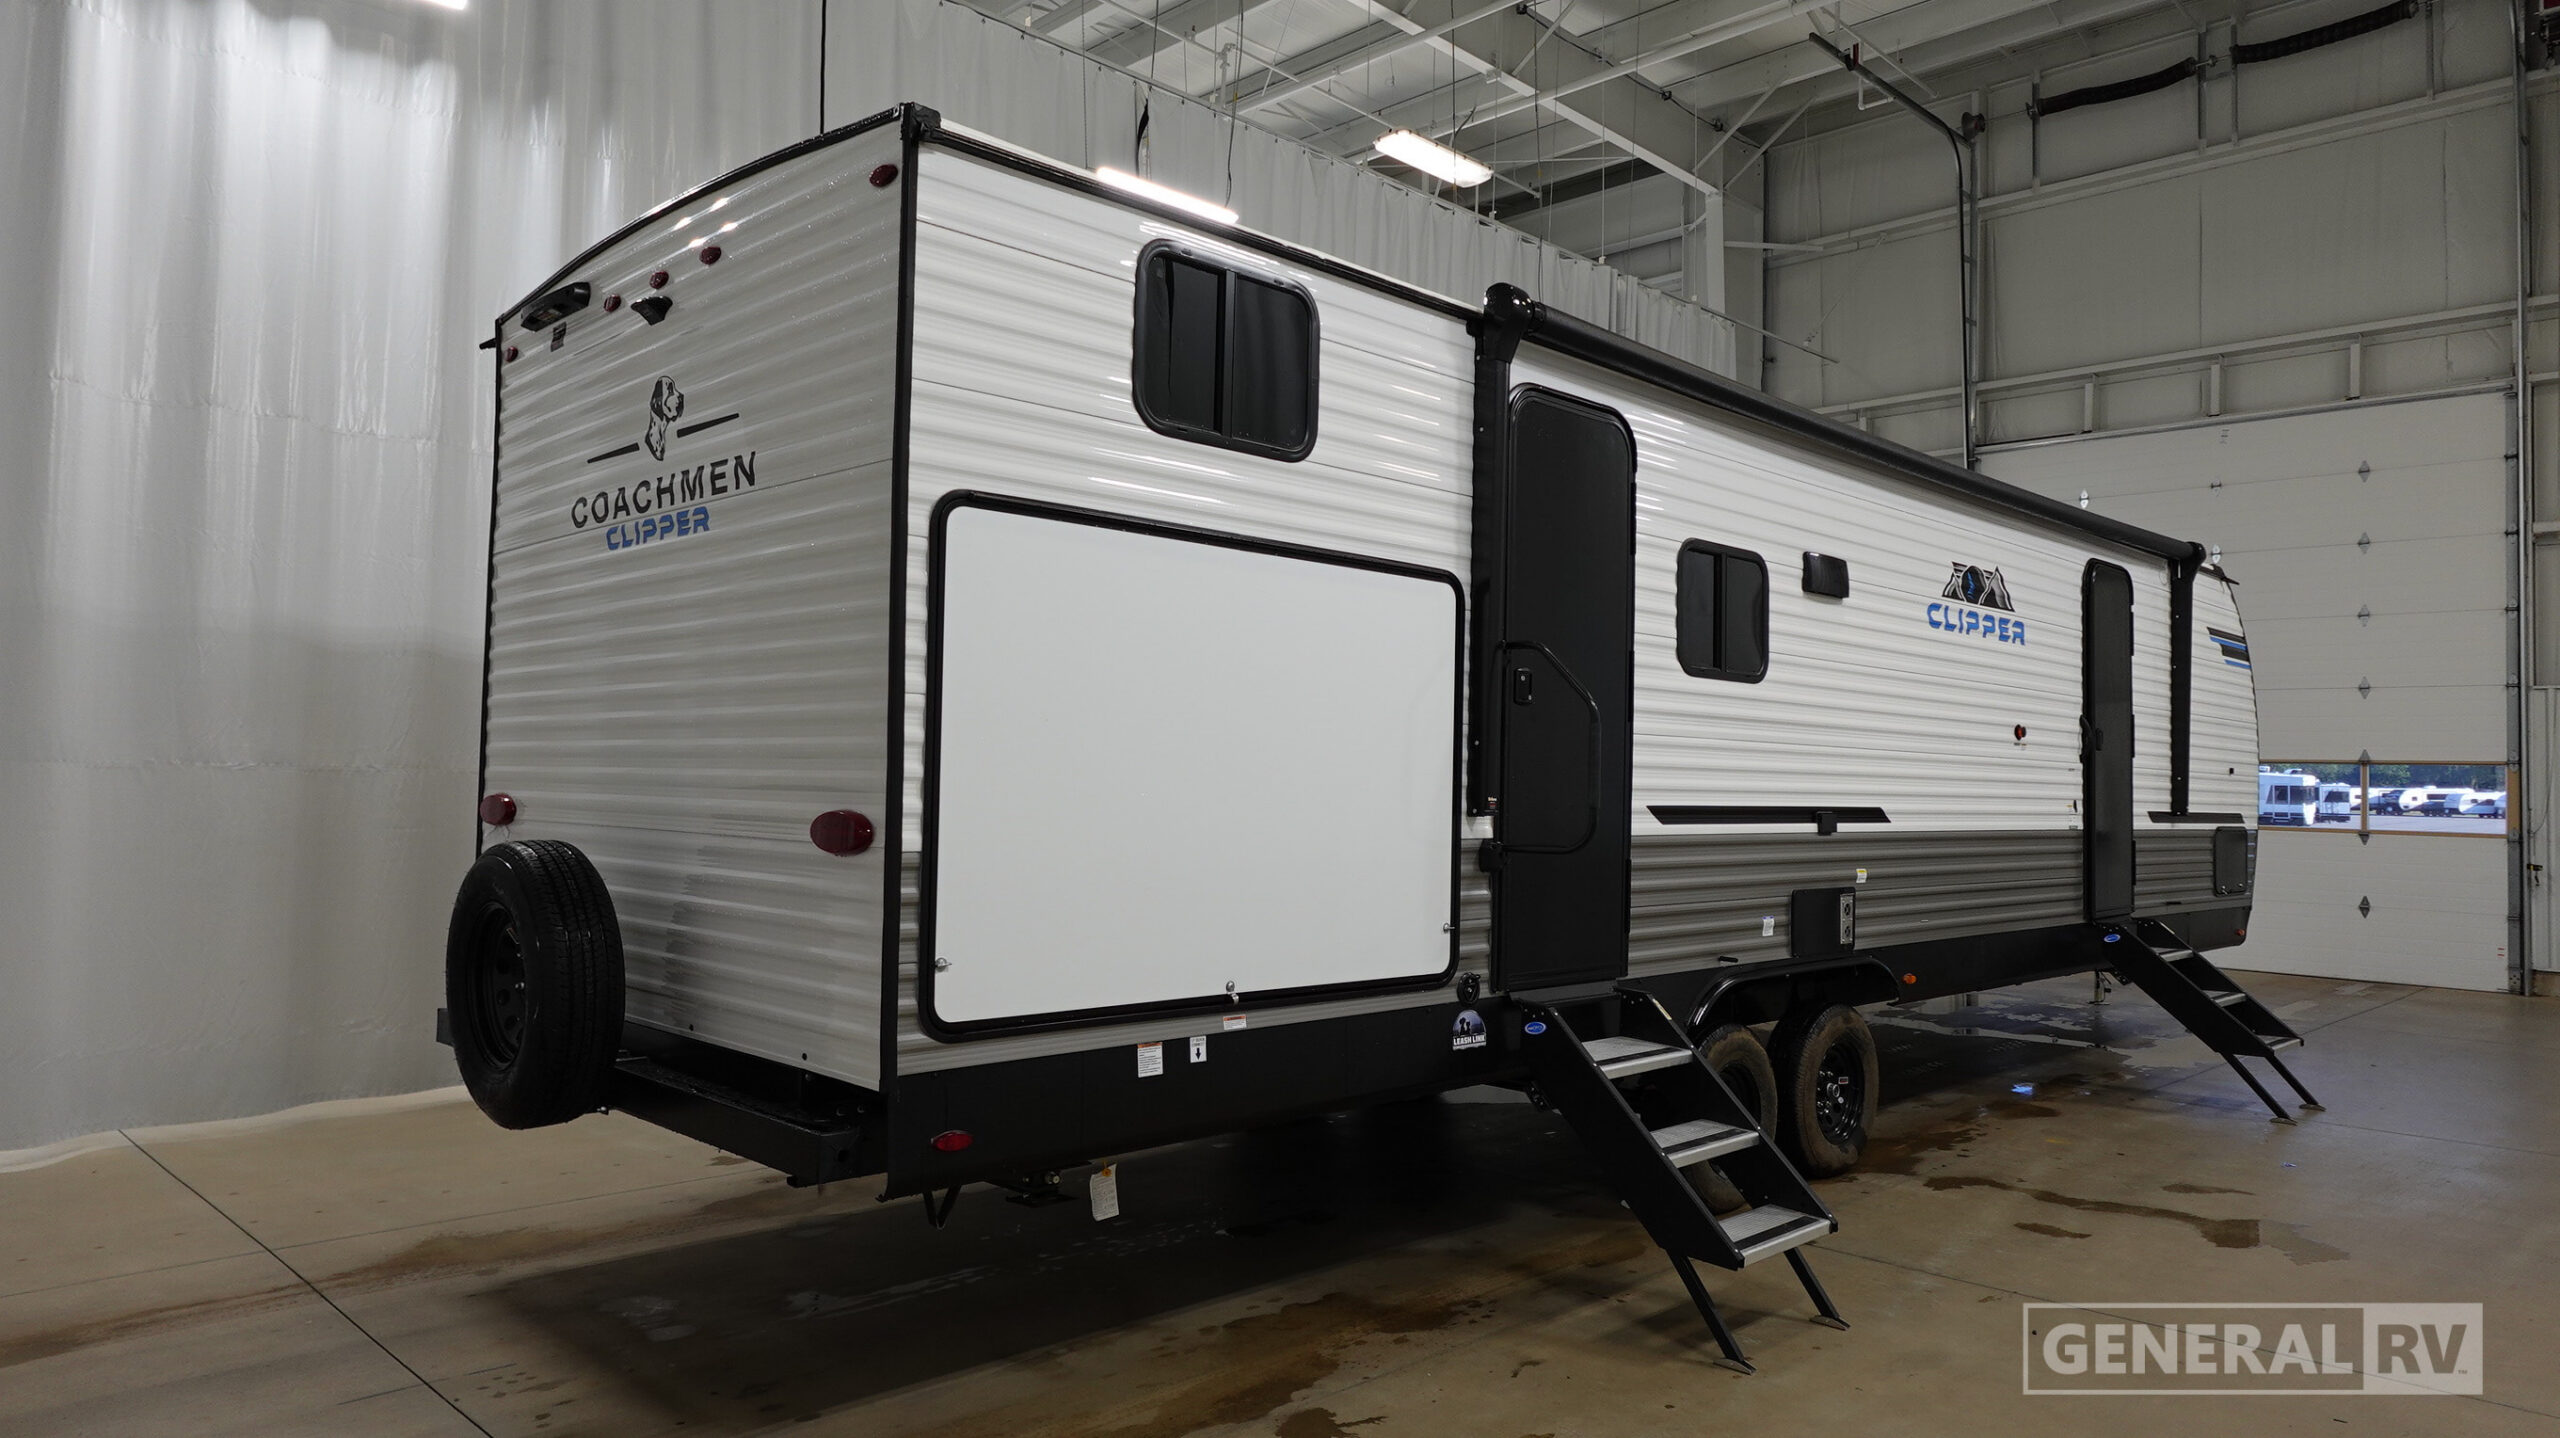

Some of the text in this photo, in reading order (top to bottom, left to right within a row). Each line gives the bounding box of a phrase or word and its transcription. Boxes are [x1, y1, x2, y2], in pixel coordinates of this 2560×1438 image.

[571, 451, 756, 528] COACHMEN
[606, 506, 710, 550] CLIPPER
[1926, 602, 2026, 646] CLIPPER
[1453, 1036, 1472, 1045] LEASH
